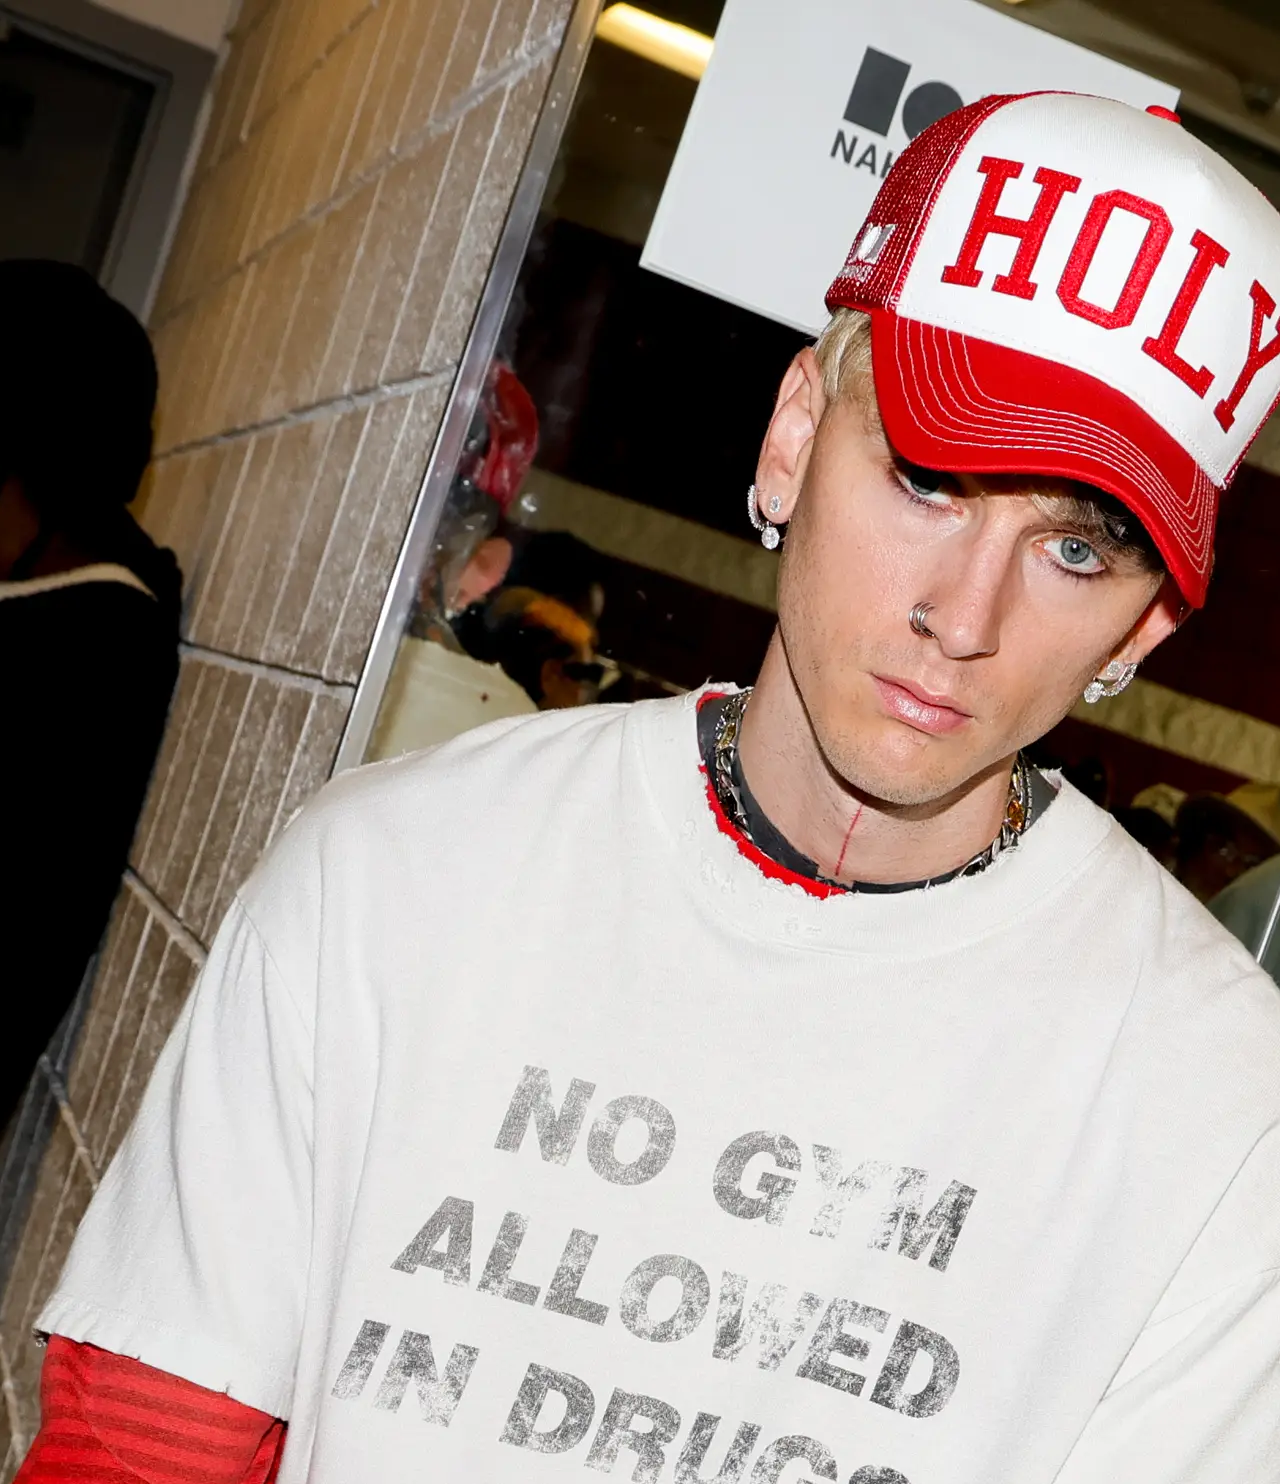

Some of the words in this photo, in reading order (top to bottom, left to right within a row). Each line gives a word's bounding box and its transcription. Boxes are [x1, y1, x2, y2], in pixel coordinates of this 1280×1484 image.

[493, 1065, 676, 1185] NO
[712, 1130, 977, 1272] GYM
[330, 1319, 479, 1427] IN
[390, 1195, 961, 1418] ALLOWED
